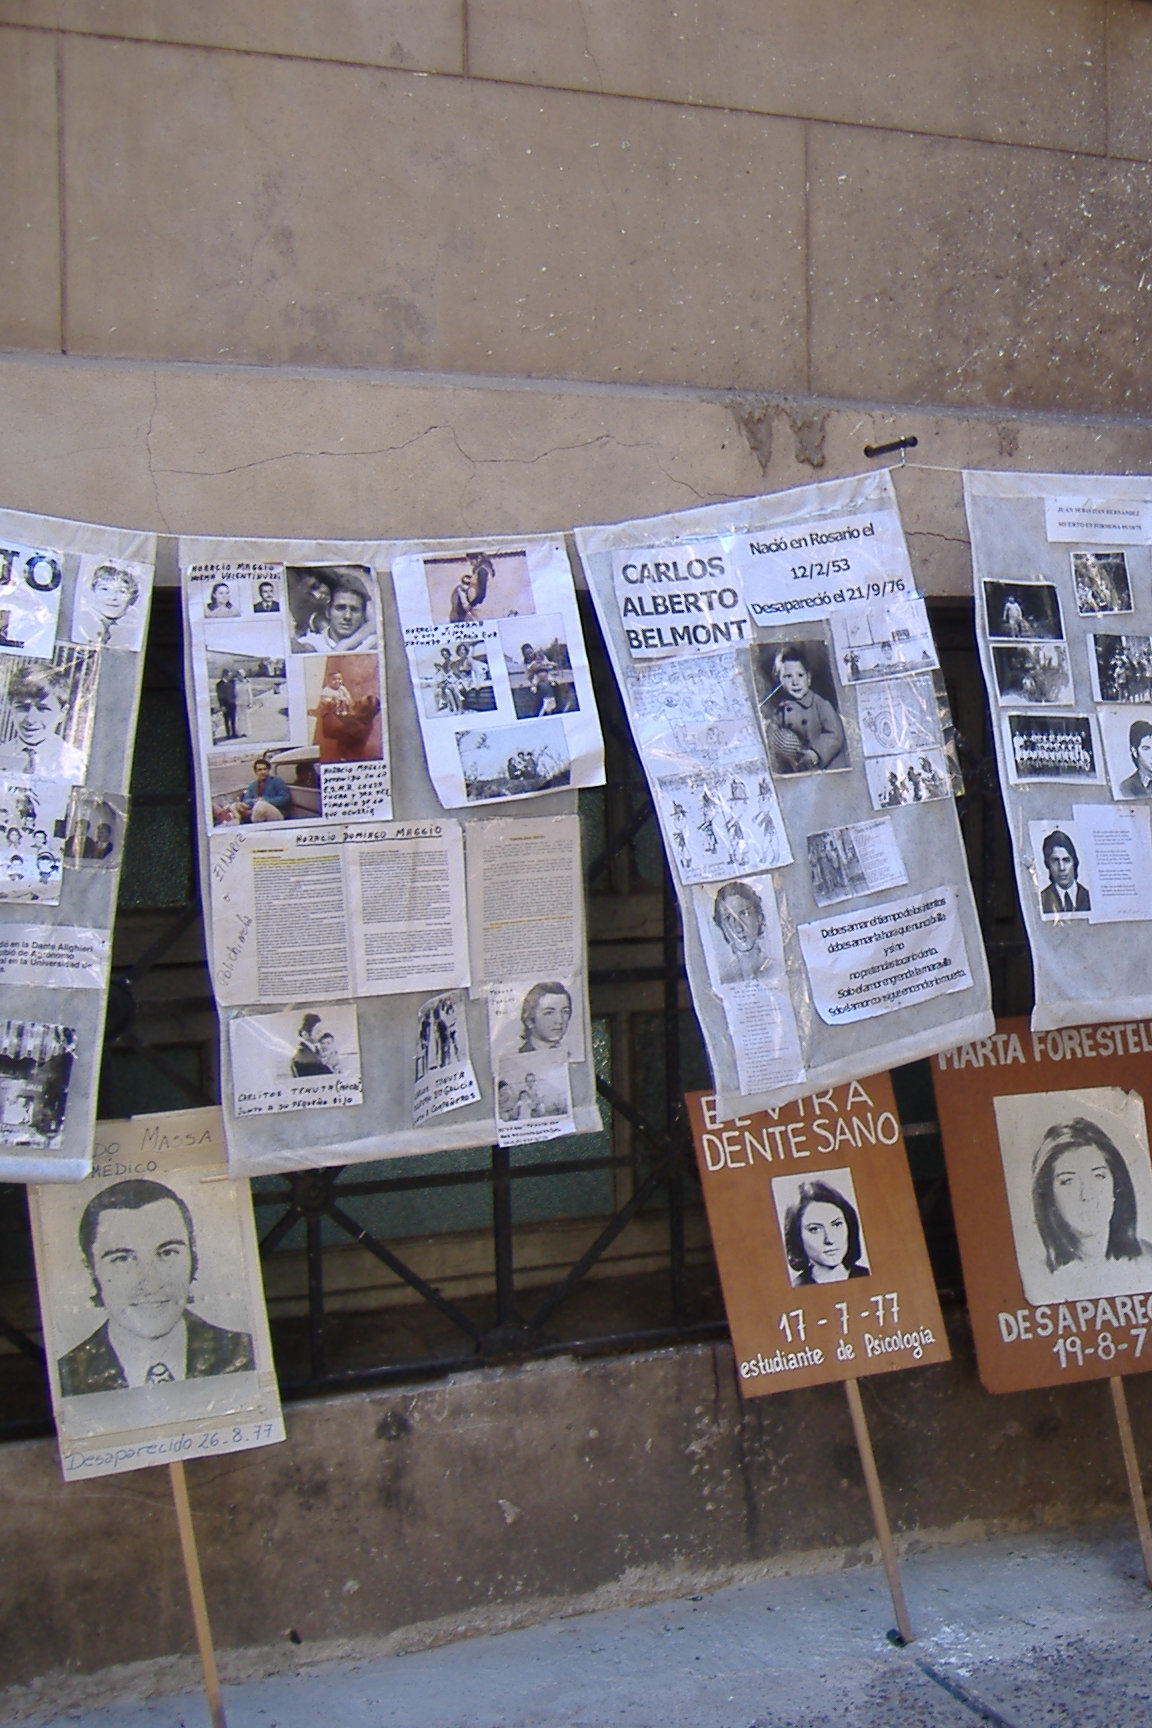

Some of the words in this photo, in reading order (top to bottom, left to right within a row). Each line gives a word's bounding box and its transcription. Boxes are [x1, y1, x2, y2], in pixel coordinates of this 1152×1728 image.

[749, 536, 788, 555] Nació
[790, 536, 808, 549] en
[809, 525, 861, 547] Rosario
[862, 522, 875, 537] el
[621, 556, 726, 585] CARLOS
[789, 557, 851, 580] 12/2/53
[622, 587, 739, 617] ALBERTO
[750, 591, 832, 615] Desapareció
[832, 589, 846, 603] el
[846, 578, 906, 601] 21/9/76
[625, 618, 748, 649] BELMONT
[938, 1033, 1026, 1070] MARTA
[739, 1346, 825, 1379] estudiante
[836, 1338, 856, 1361] de
[64, 1432, 193, 1472] Desaparecido
